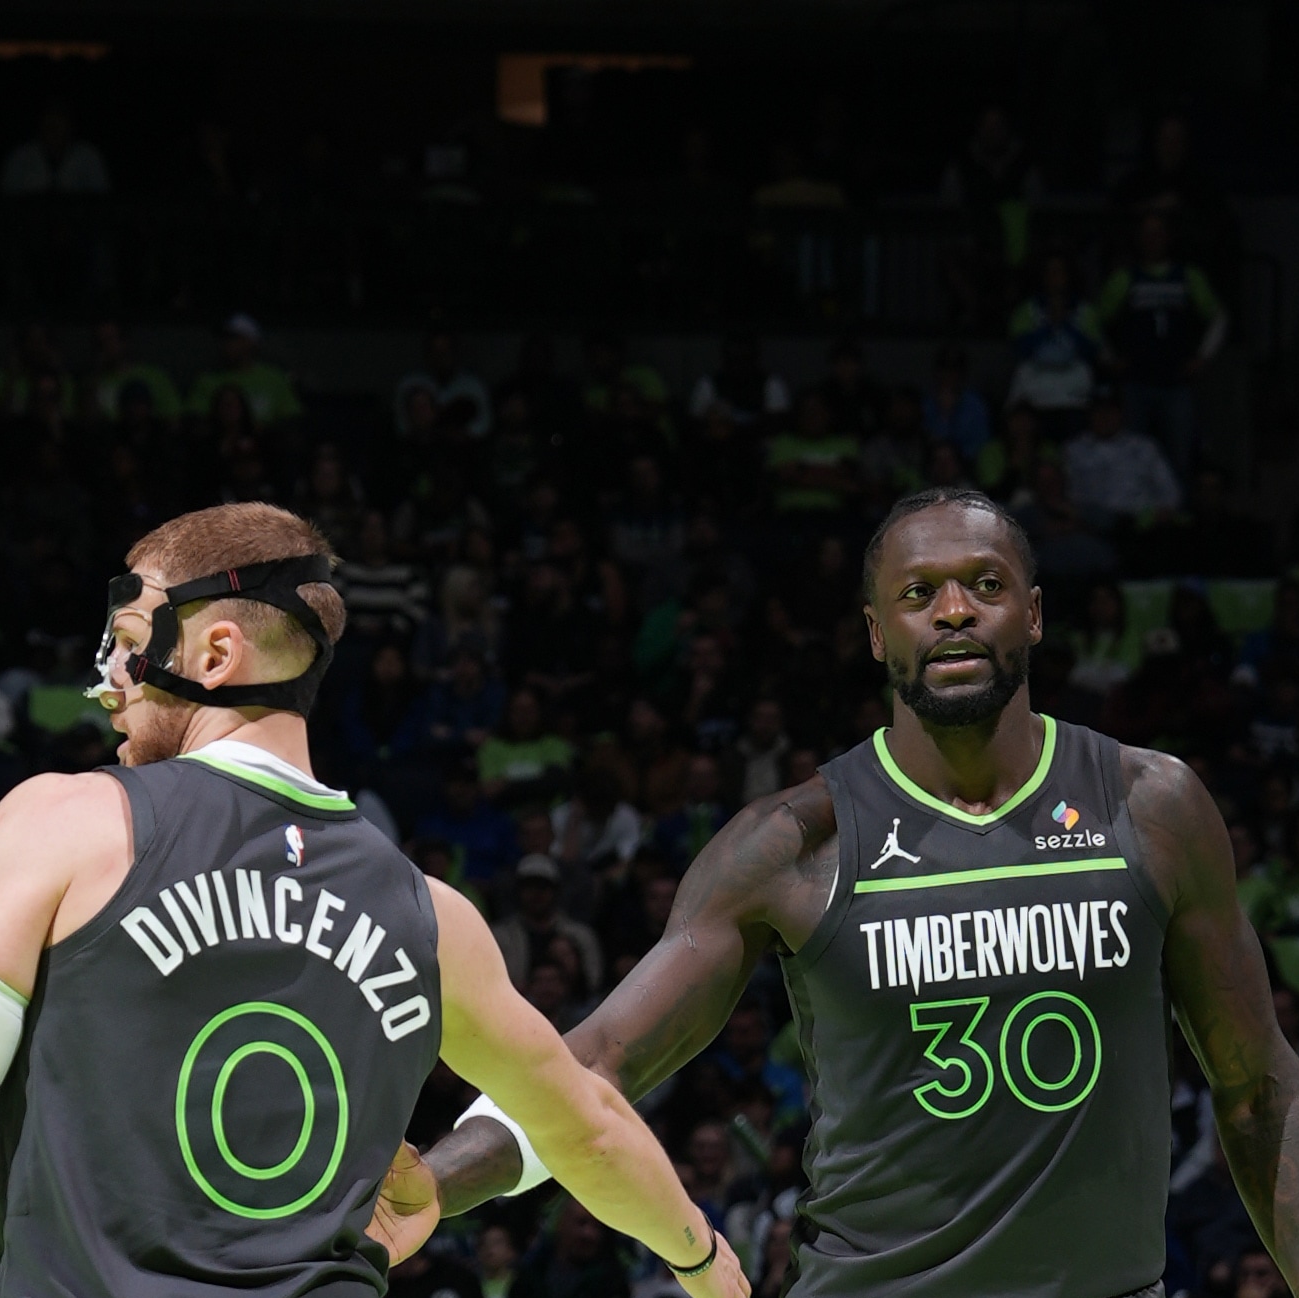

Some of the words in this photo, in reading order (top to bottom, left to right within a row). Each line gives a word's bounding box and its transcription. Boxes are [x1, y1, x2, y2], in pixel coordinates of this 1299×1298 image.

[1034, 829, 1106, 851] sezzle
[120, 868, 432, 1042] DIVINCENZO
[859, 900, 1131, 996] TIMBERWOLVES
[175, 1001, 350, 1219] 0
[909, 990, 1102, 1120] 30
